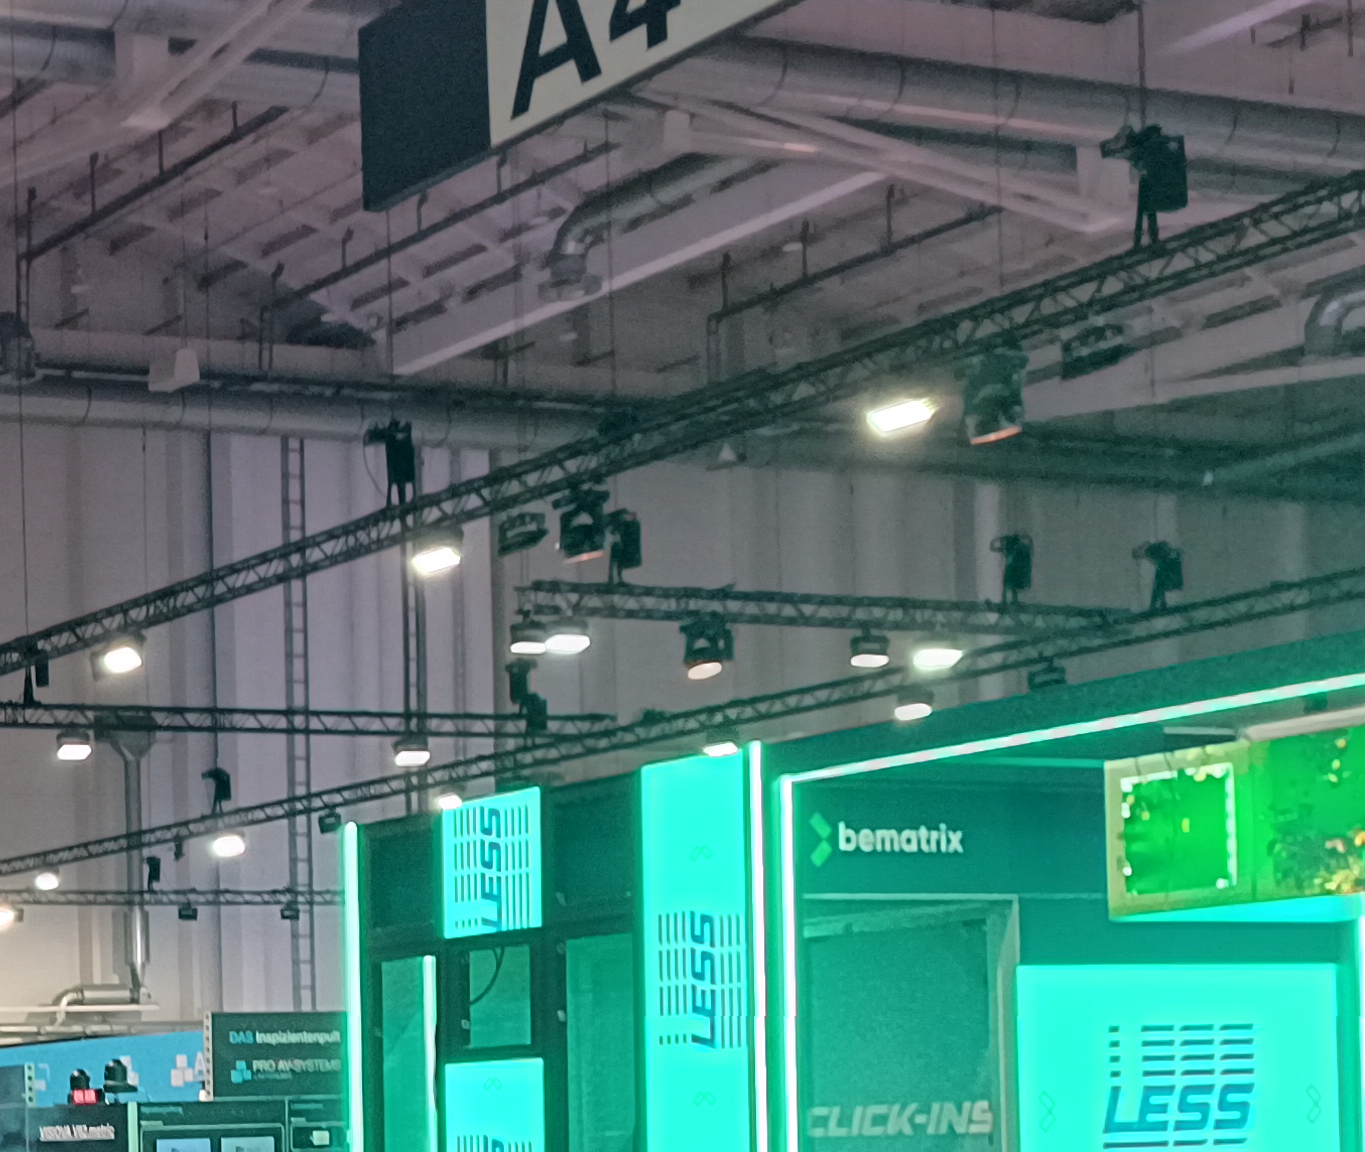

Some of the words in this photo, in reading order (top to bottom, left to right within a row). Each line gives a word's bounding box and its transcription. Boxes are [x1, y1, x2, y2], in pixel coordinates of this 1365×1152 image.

[837, 821, 964, 854] bematrix
[480, 805, 503, 933] LESS
[690, 909, 717, 1050] LESS
[229, 1030, 254, 1044] DAS
[255, 1029, 341, 1047] Inspizientenpult
[252, 1059, 276, 1072] PRO
[277, 1058, 341, 1073] AV-SYSTEMS
[808, 1099, 995, 1138] CLICK-INS
[1102, 1082, 1256, 1135] LESS
